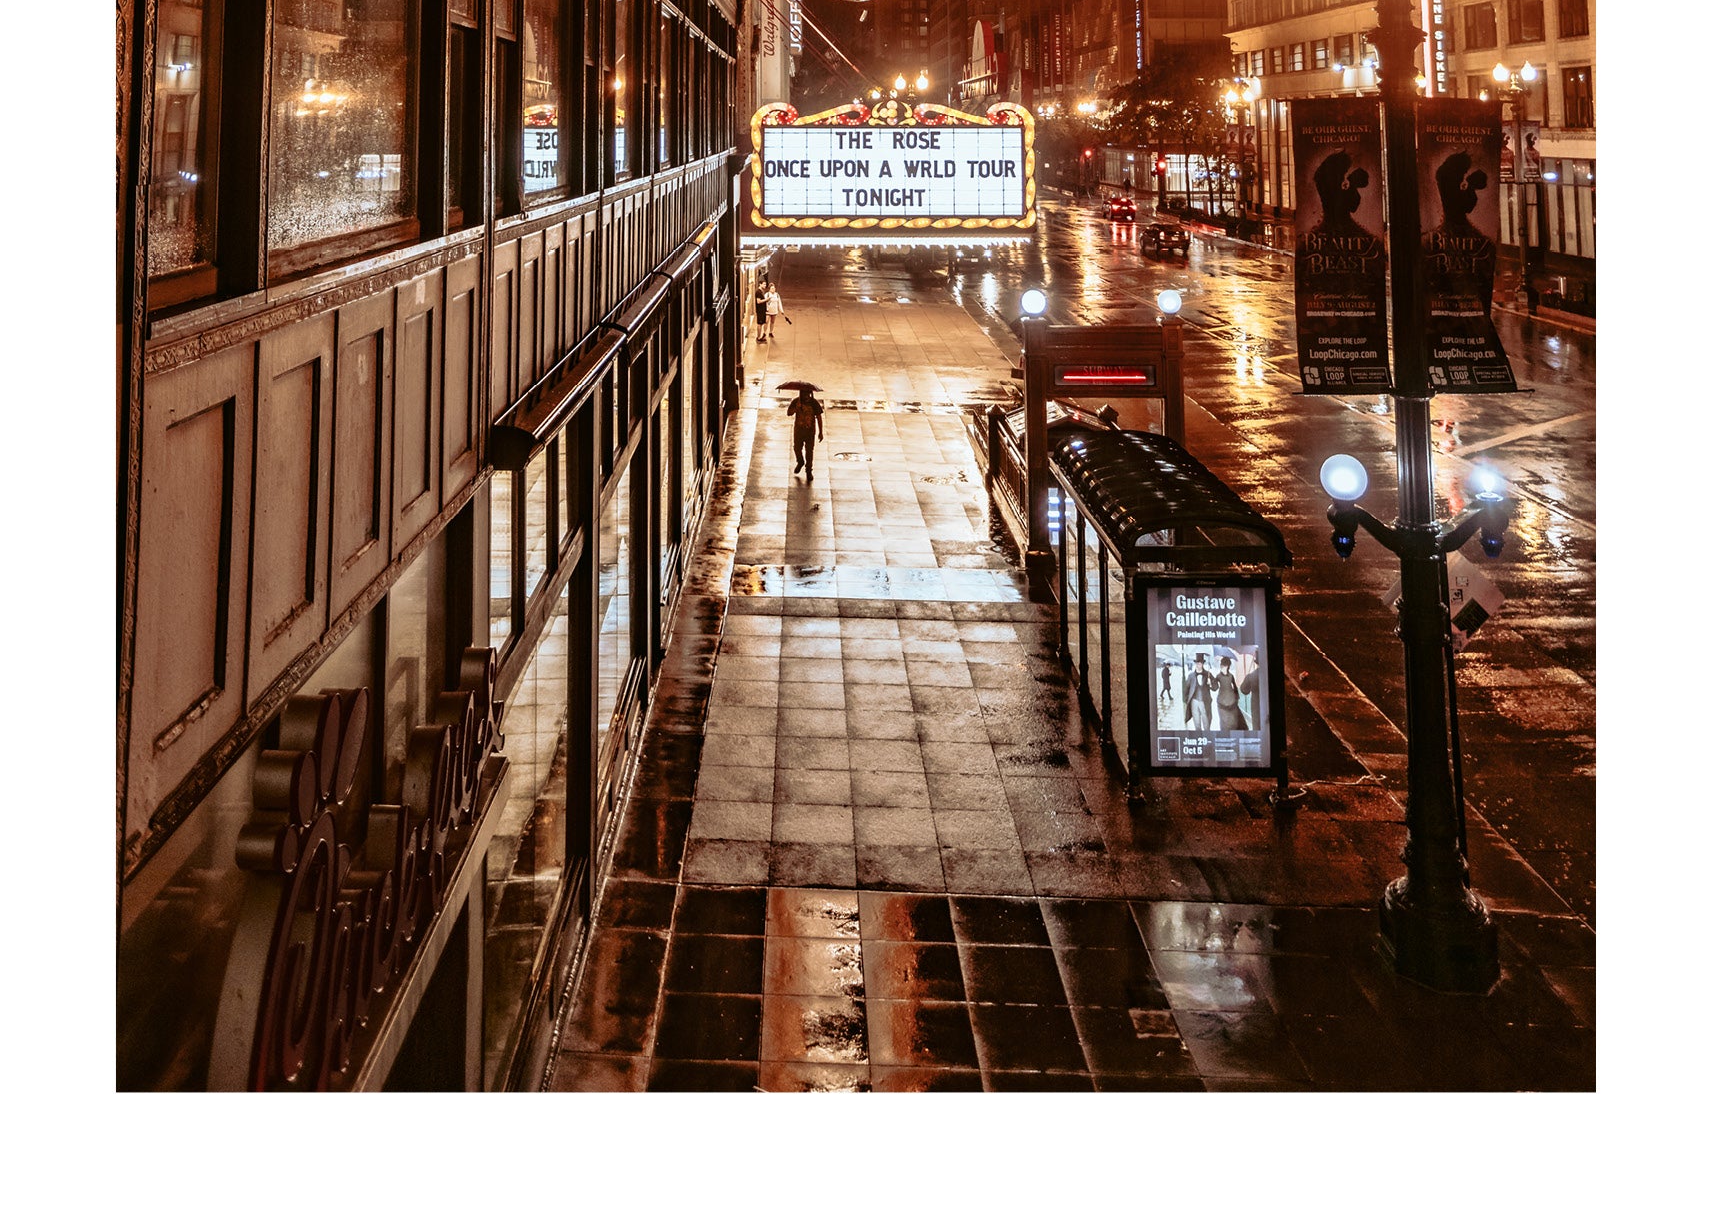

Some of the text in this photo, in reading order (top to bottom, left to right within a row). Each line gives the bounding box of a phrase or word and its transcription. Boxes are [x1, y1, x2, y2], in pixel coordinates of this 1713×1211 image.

[1434, 30, 1446, 92] SISKEL
[1302, 126, 1314, 135] BE
[1315, 125, 1334, 134] OUR
[1426, 125, 1438, 134] BE
[1438, 125, 1459, 134] OUR
[836, 131, 941, 150] THE ROSE
[1312, 134, 1361, 144] CHICAGO!
[1435, 134, 1483, 144] CHICAGO!
[764, 159, 1016, 179] ONCE UPON A WRLD TOUR
[842, 188, 926, 207] TONIGHT
[1309, 348, 1377, 361] LoopChicago.com
[1083, 365, 1124, 375] SUBWAY
[1325, 372, 1345, 381] LOOP
[1449, 371, 1469, 380] LOOP
[1176, 594, 1235, 610] Gustave
[1166, 612, 1246, 627] Caillebotte
[1177, 630, 1236, 639] Painting His World
[1183, 737, 1197, 746] Jun
[1183, 746, 1203, 755] Oct 5
